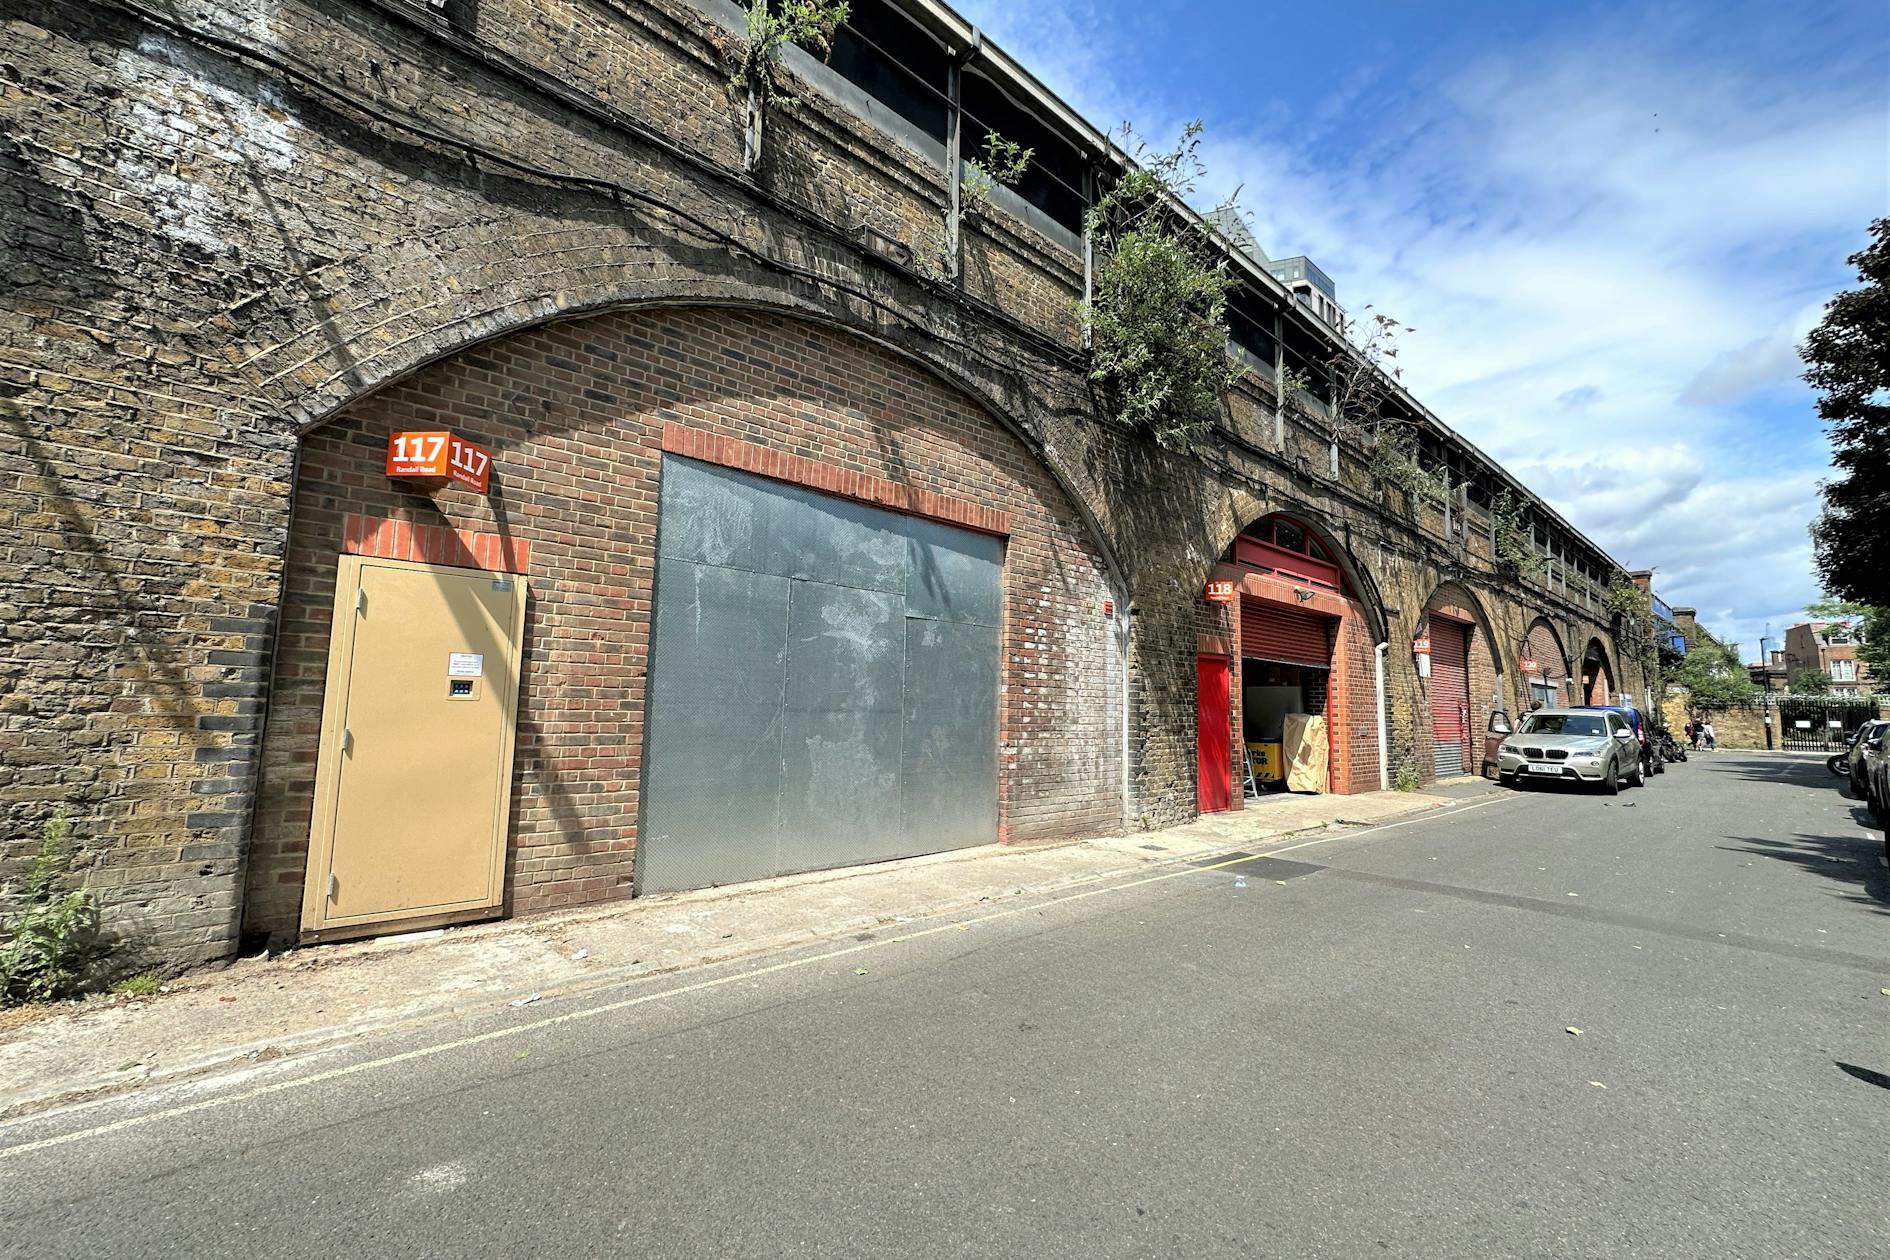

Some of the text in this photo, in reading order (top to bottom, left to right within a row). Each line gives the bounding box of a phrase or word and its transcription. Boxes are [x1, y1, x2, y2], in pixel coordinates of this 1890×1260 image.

[392, 436, 446, 462] 117
[450, 441, 488, 476] 117
[396, 465, 436, 473] Randall Road
[453, 470, 482, 487] Randall Road
[1207, 583, 1231, 595] 118
